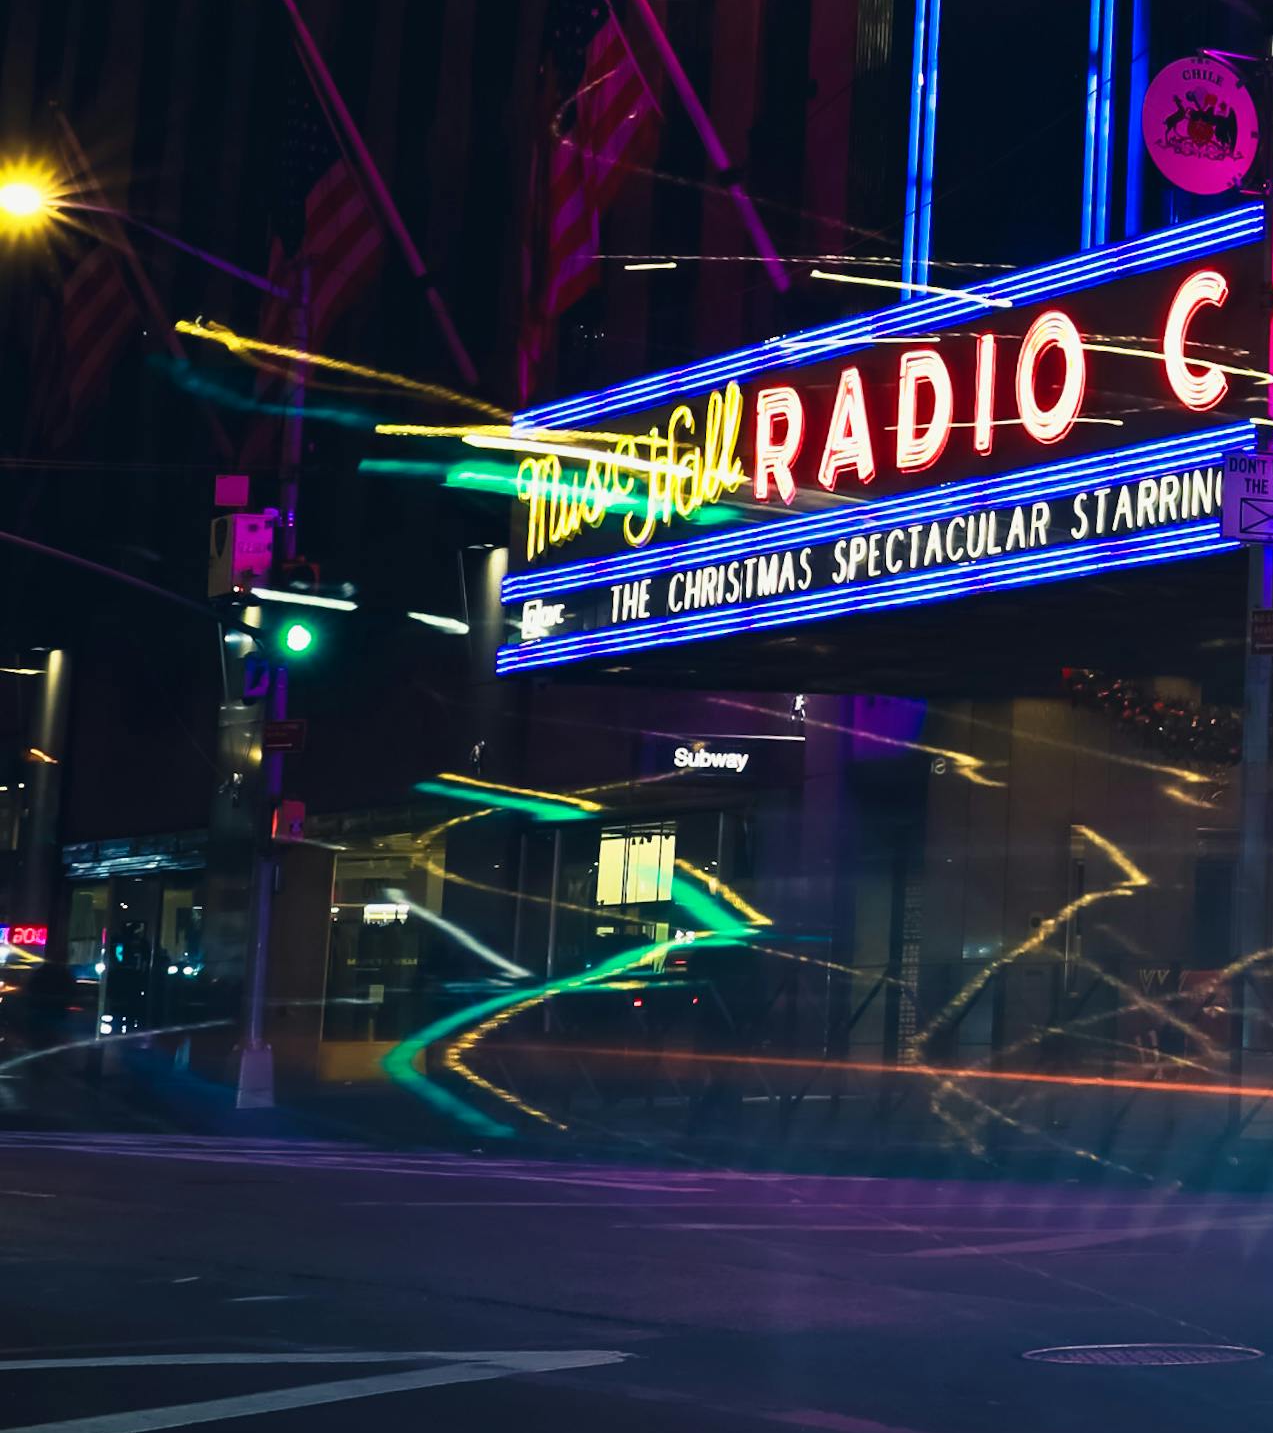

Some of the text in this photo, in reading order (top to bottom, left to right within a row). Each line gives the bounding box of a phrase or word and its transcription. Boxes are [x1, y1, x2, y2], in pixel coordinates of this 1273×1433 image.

[1182, 68, 1224, 86] CHILE
[753, 308, 1086, 505] RADIO
[1229, 457, 1268, 477] DON'T
[1244, 478, 1269, 496] THE
[610, 561, 651, 625] THE
[667, 525, 813, 613] CHRISTMAS
[831, 498, 1050, 586] SPECTACULAR
[673, 747, 749, 773] Subway
